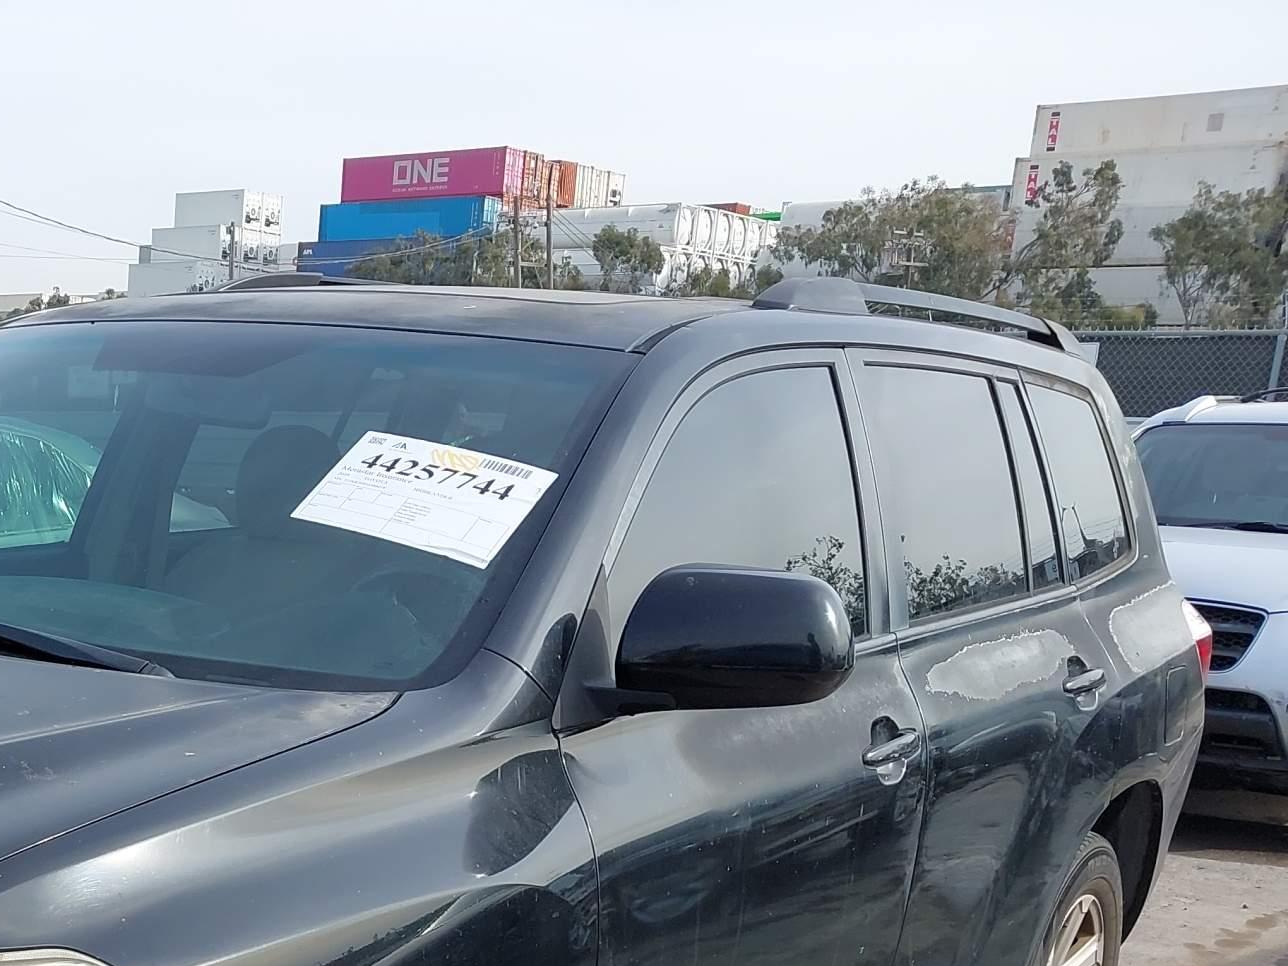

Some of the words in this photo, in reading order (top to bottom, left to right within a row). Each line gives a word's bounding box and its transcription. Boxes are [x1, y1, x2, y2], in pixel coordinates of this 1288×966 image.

[1047, 118, 1059, 144] TAL
[392, 157, 450, 185] ONE
[361, 453, 515, 500] 44257744
